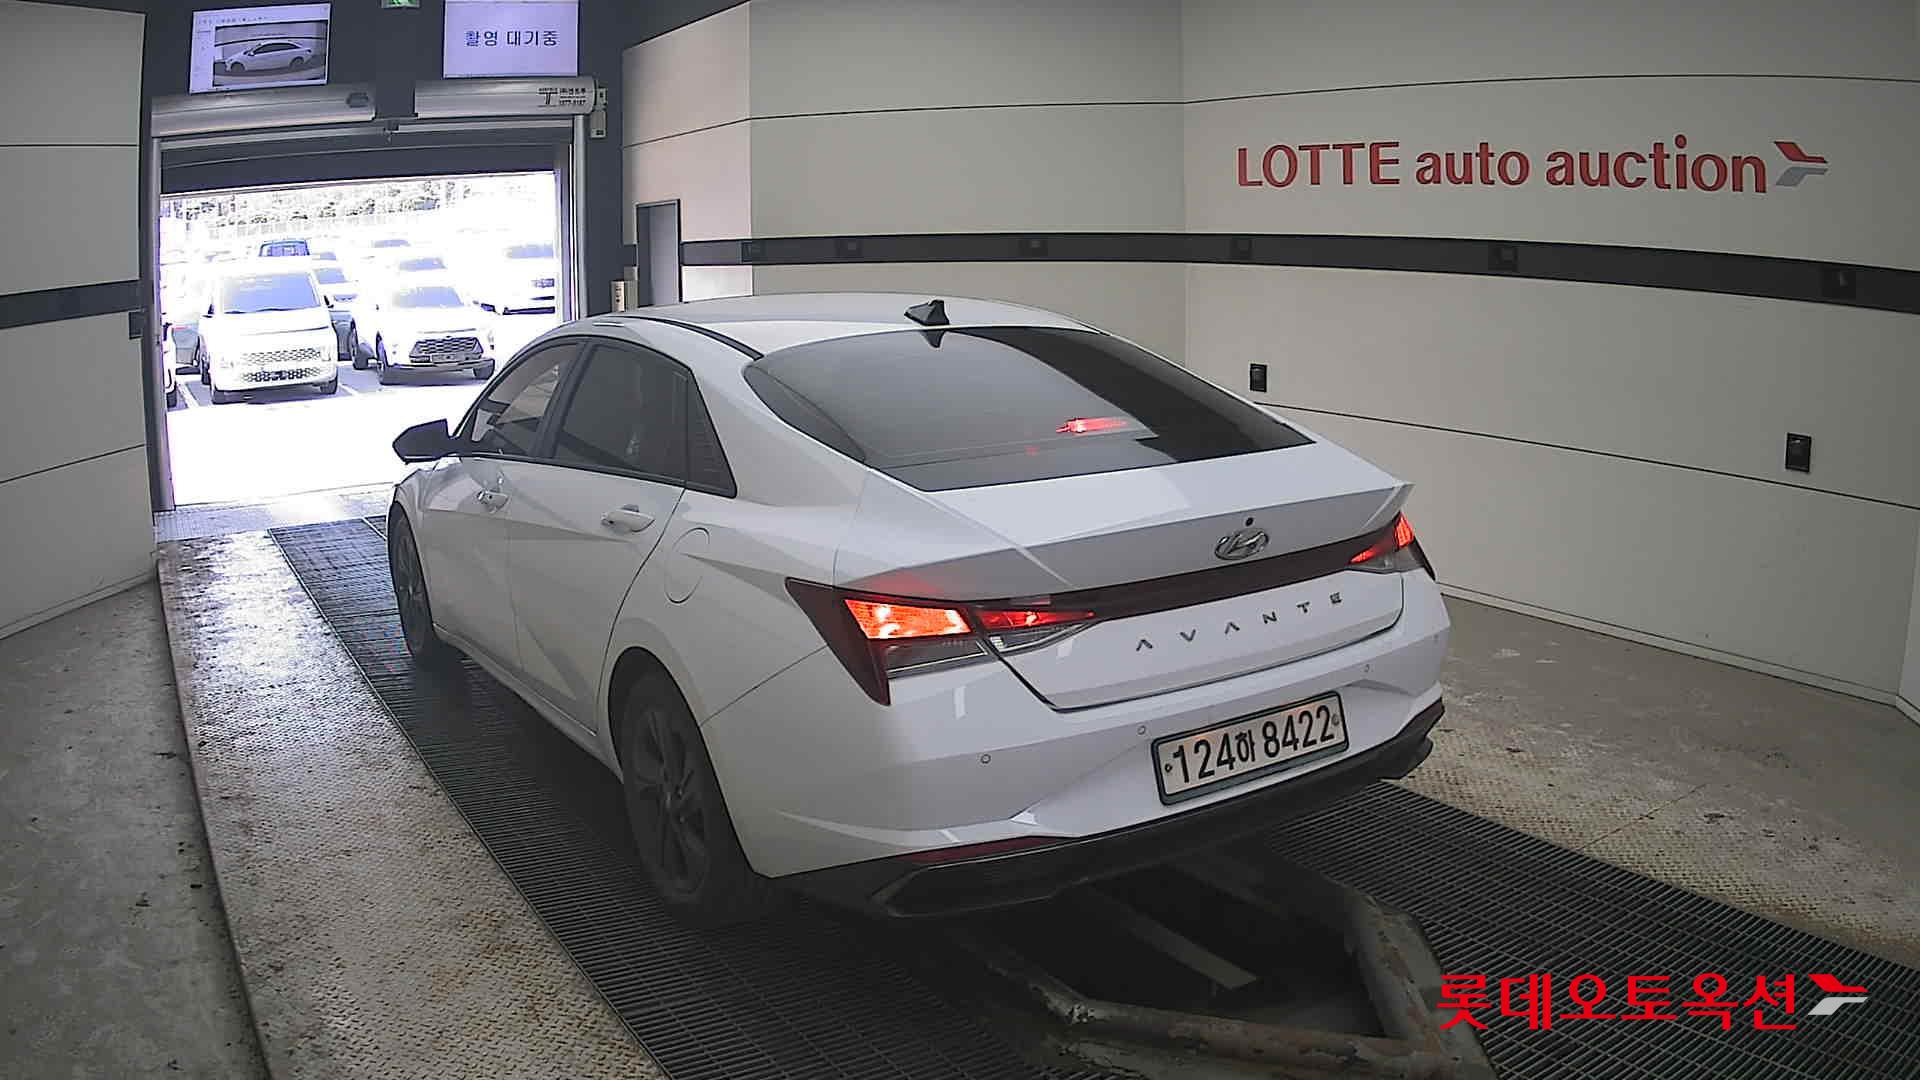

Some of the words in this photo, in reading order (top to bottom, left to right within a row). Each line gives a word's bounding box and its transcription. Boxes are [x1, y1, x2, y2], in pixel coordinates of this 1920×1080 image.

[506, 30, 558, 47] 대기중
[1236, 141, 1400, 188] LOTTE
[1414, 141, 1532, 186] auto
[1545, 134, 1767, 193] auction
[1135, 591, 1343, 652] AVANTE
[1261, 704, 1335, 759] 8422
